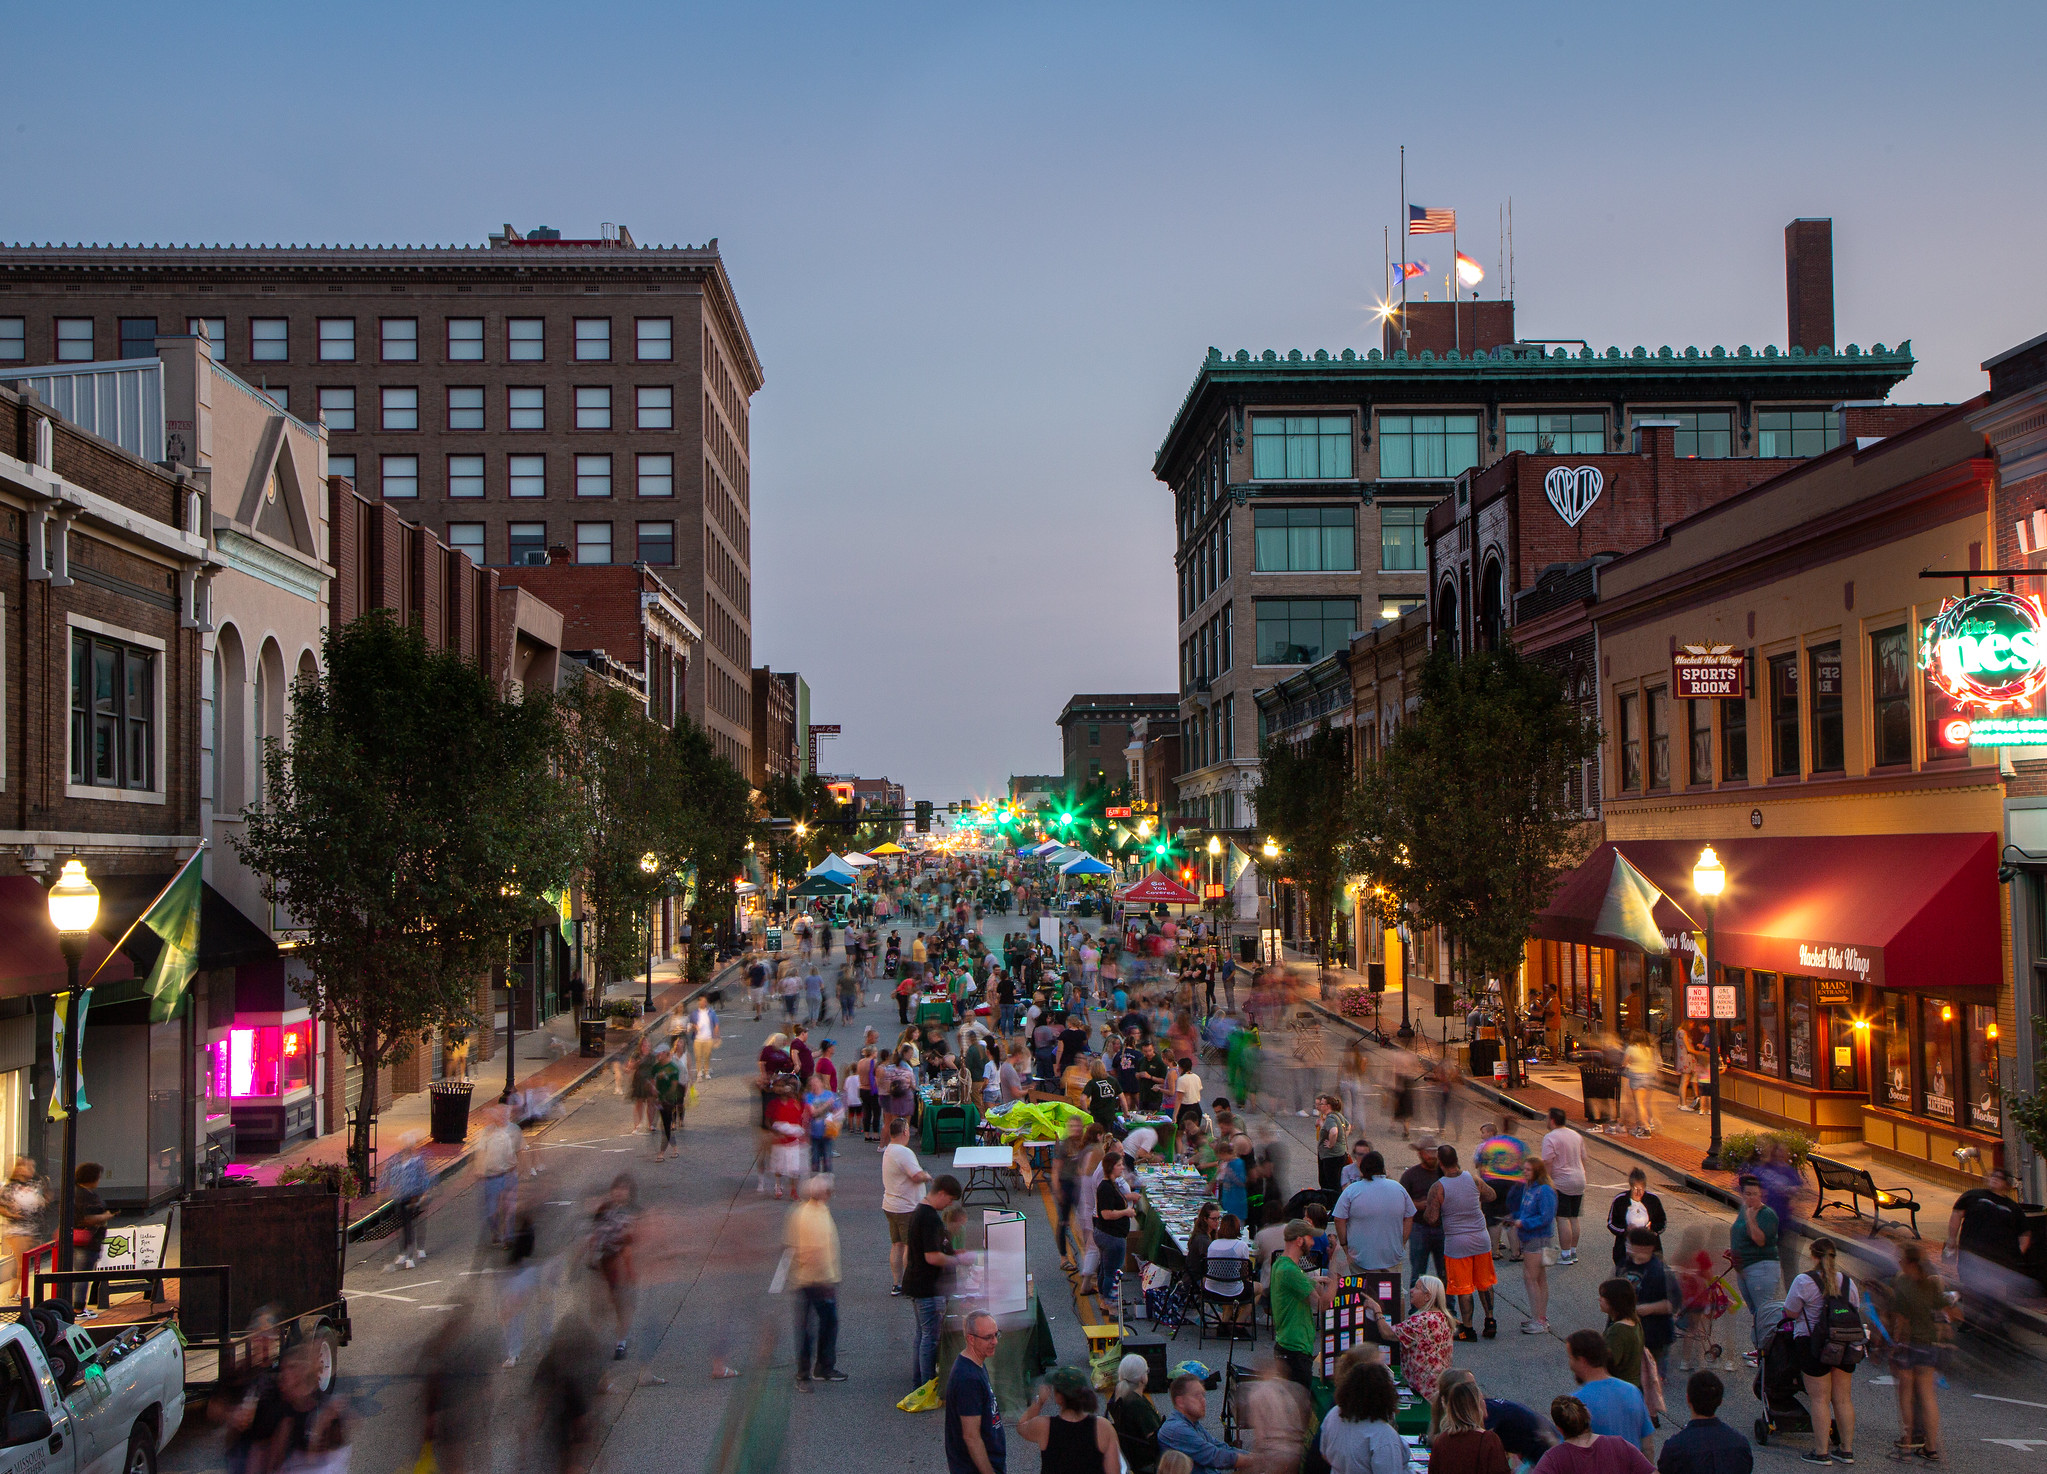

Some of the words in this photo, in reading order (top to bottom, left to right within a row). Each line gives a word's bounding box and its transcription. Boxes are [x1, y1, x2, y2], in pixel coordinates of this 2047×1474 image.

[1549, 469, 1600, 521] JOPLIN
[1962, 616, 1996, 635] the
[1675, 655, 1703, 665] Hackett
[1703, 655, 1718, 665] Hot
[1719, 655, 1743, 667] Wings
[1940, 631, 2047, 673] nes
[1682, 668, 1736, 680] SPORTS
[1691, 681, 1730, 693] ROOM
[1680, 931, 1696, 951] Roo
[1799, 944, 1827, 968] Hackett
[1828, 946, 1844, 970] Hot
[1844, 947, 1870, 980] Wings
[1820, 981, 1847, 990] MAIN
[1889, 1087, 1910, 1102] Soccer
[1971, 1107, 1999, 1128] Hockey
[1339, 1276, 1367, 1289] SOURI
[13, 1446, 45, 1473] MISSOURI
